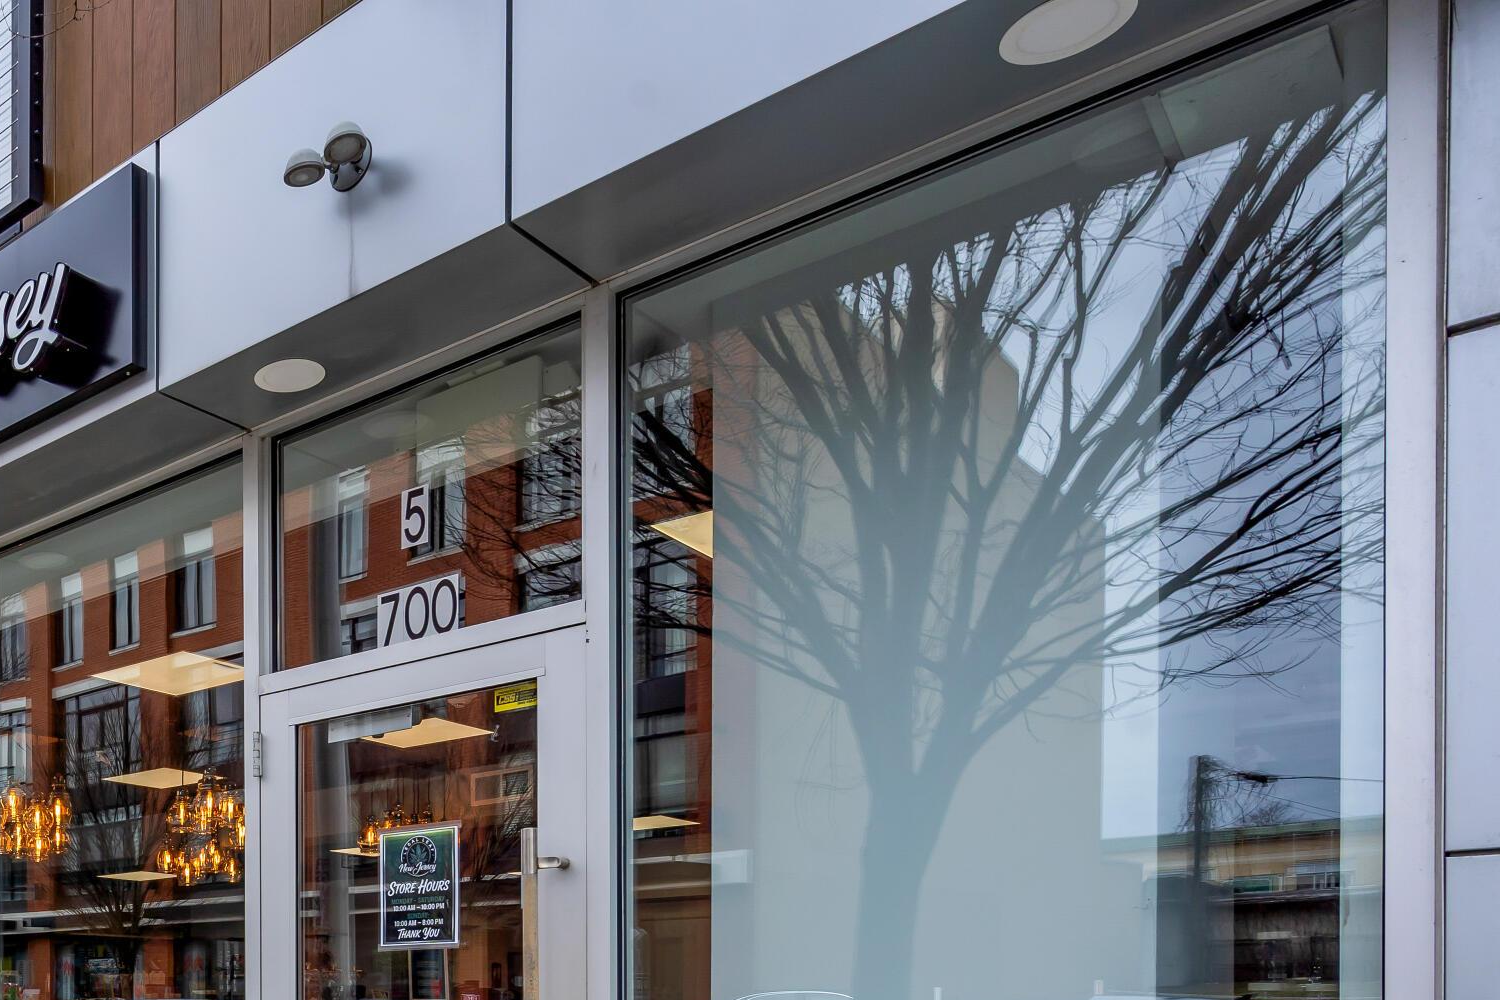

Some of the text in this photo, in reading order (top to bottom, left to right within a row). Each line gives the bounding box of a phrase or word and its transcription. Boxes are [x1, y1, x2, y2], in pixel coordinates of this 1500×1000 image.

[404, 488, 426, 543] 5
[380, 578, 458, 647] 700
[398, 864, 414, 872] New
[388, 878, 450, 896] STORE HOURS
[398, 926, 440, 940] THANK YOU
